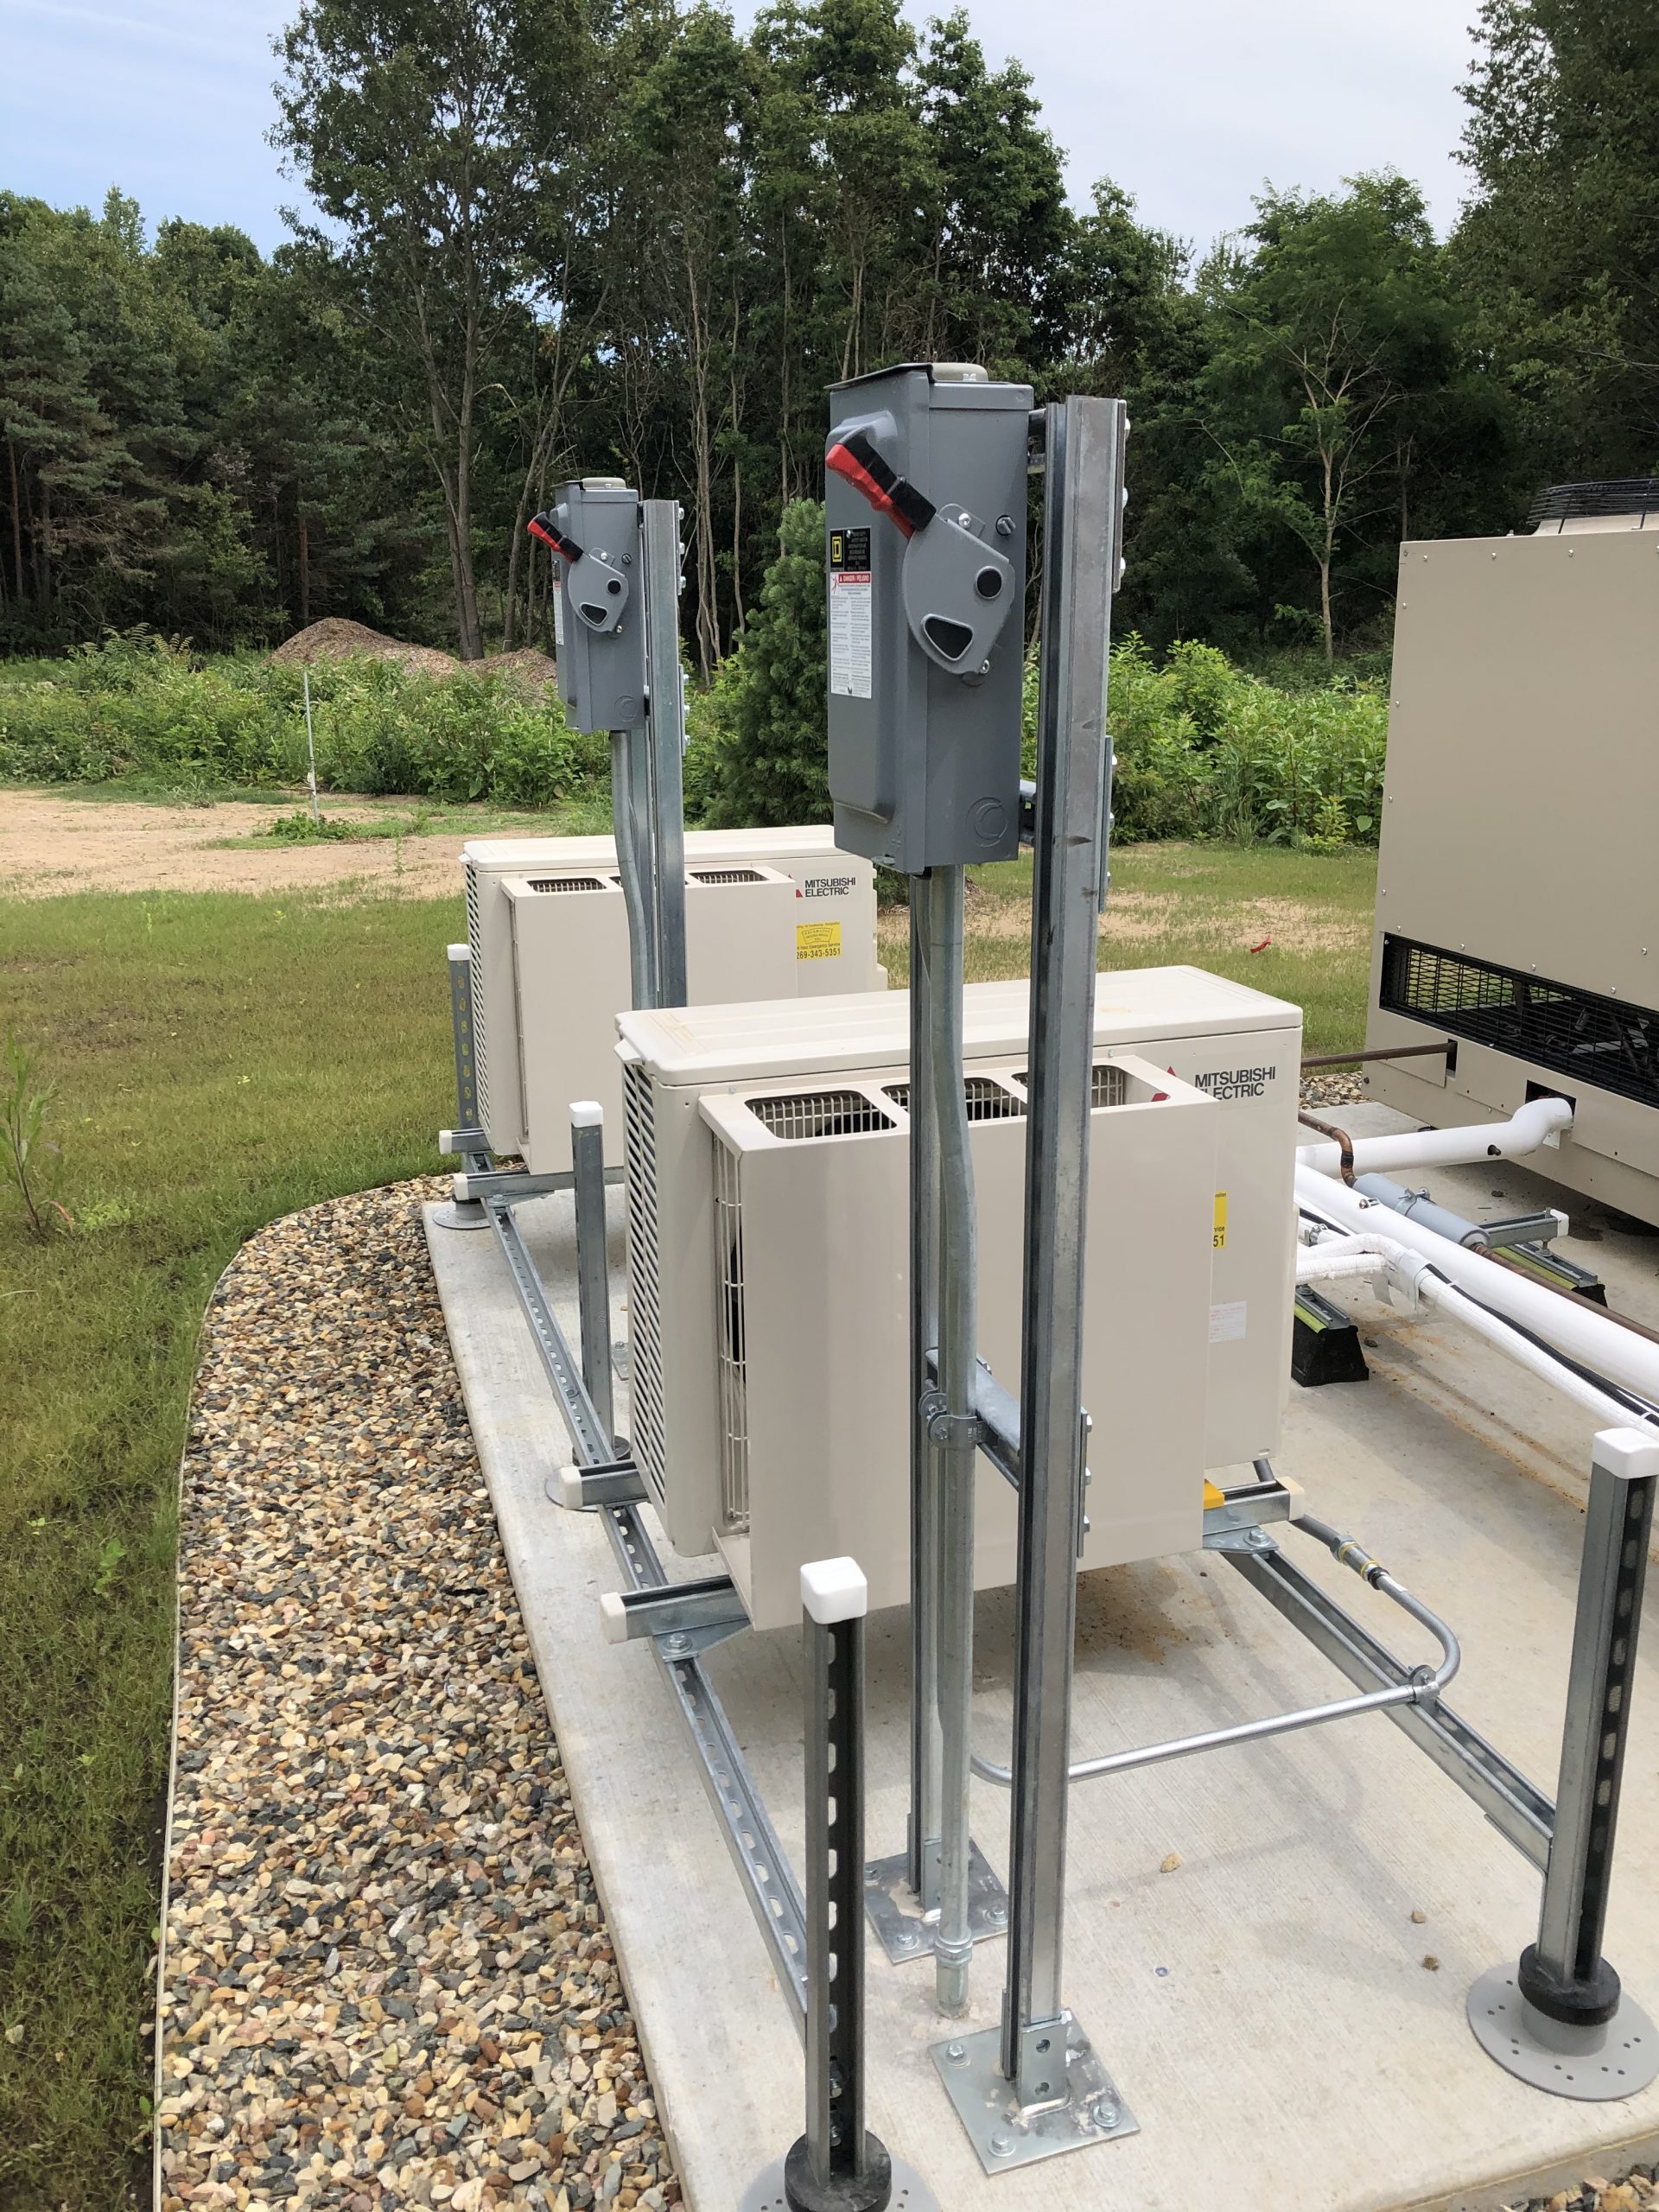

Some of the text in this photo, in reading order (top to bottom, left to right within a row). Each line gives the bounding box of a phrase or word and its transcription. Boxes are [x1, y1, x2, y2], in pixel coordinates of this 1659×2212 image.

[805, 877, 855, 888] MITSUBISHI
[805, 887, 849, 897] ELECTRIC
[797, 948, 841, 959] 269-343-5351
[1195, 1066, 1275, 1087] MITSUBISHI
[1200, 1083, 1264, 1100] ECTRIC
